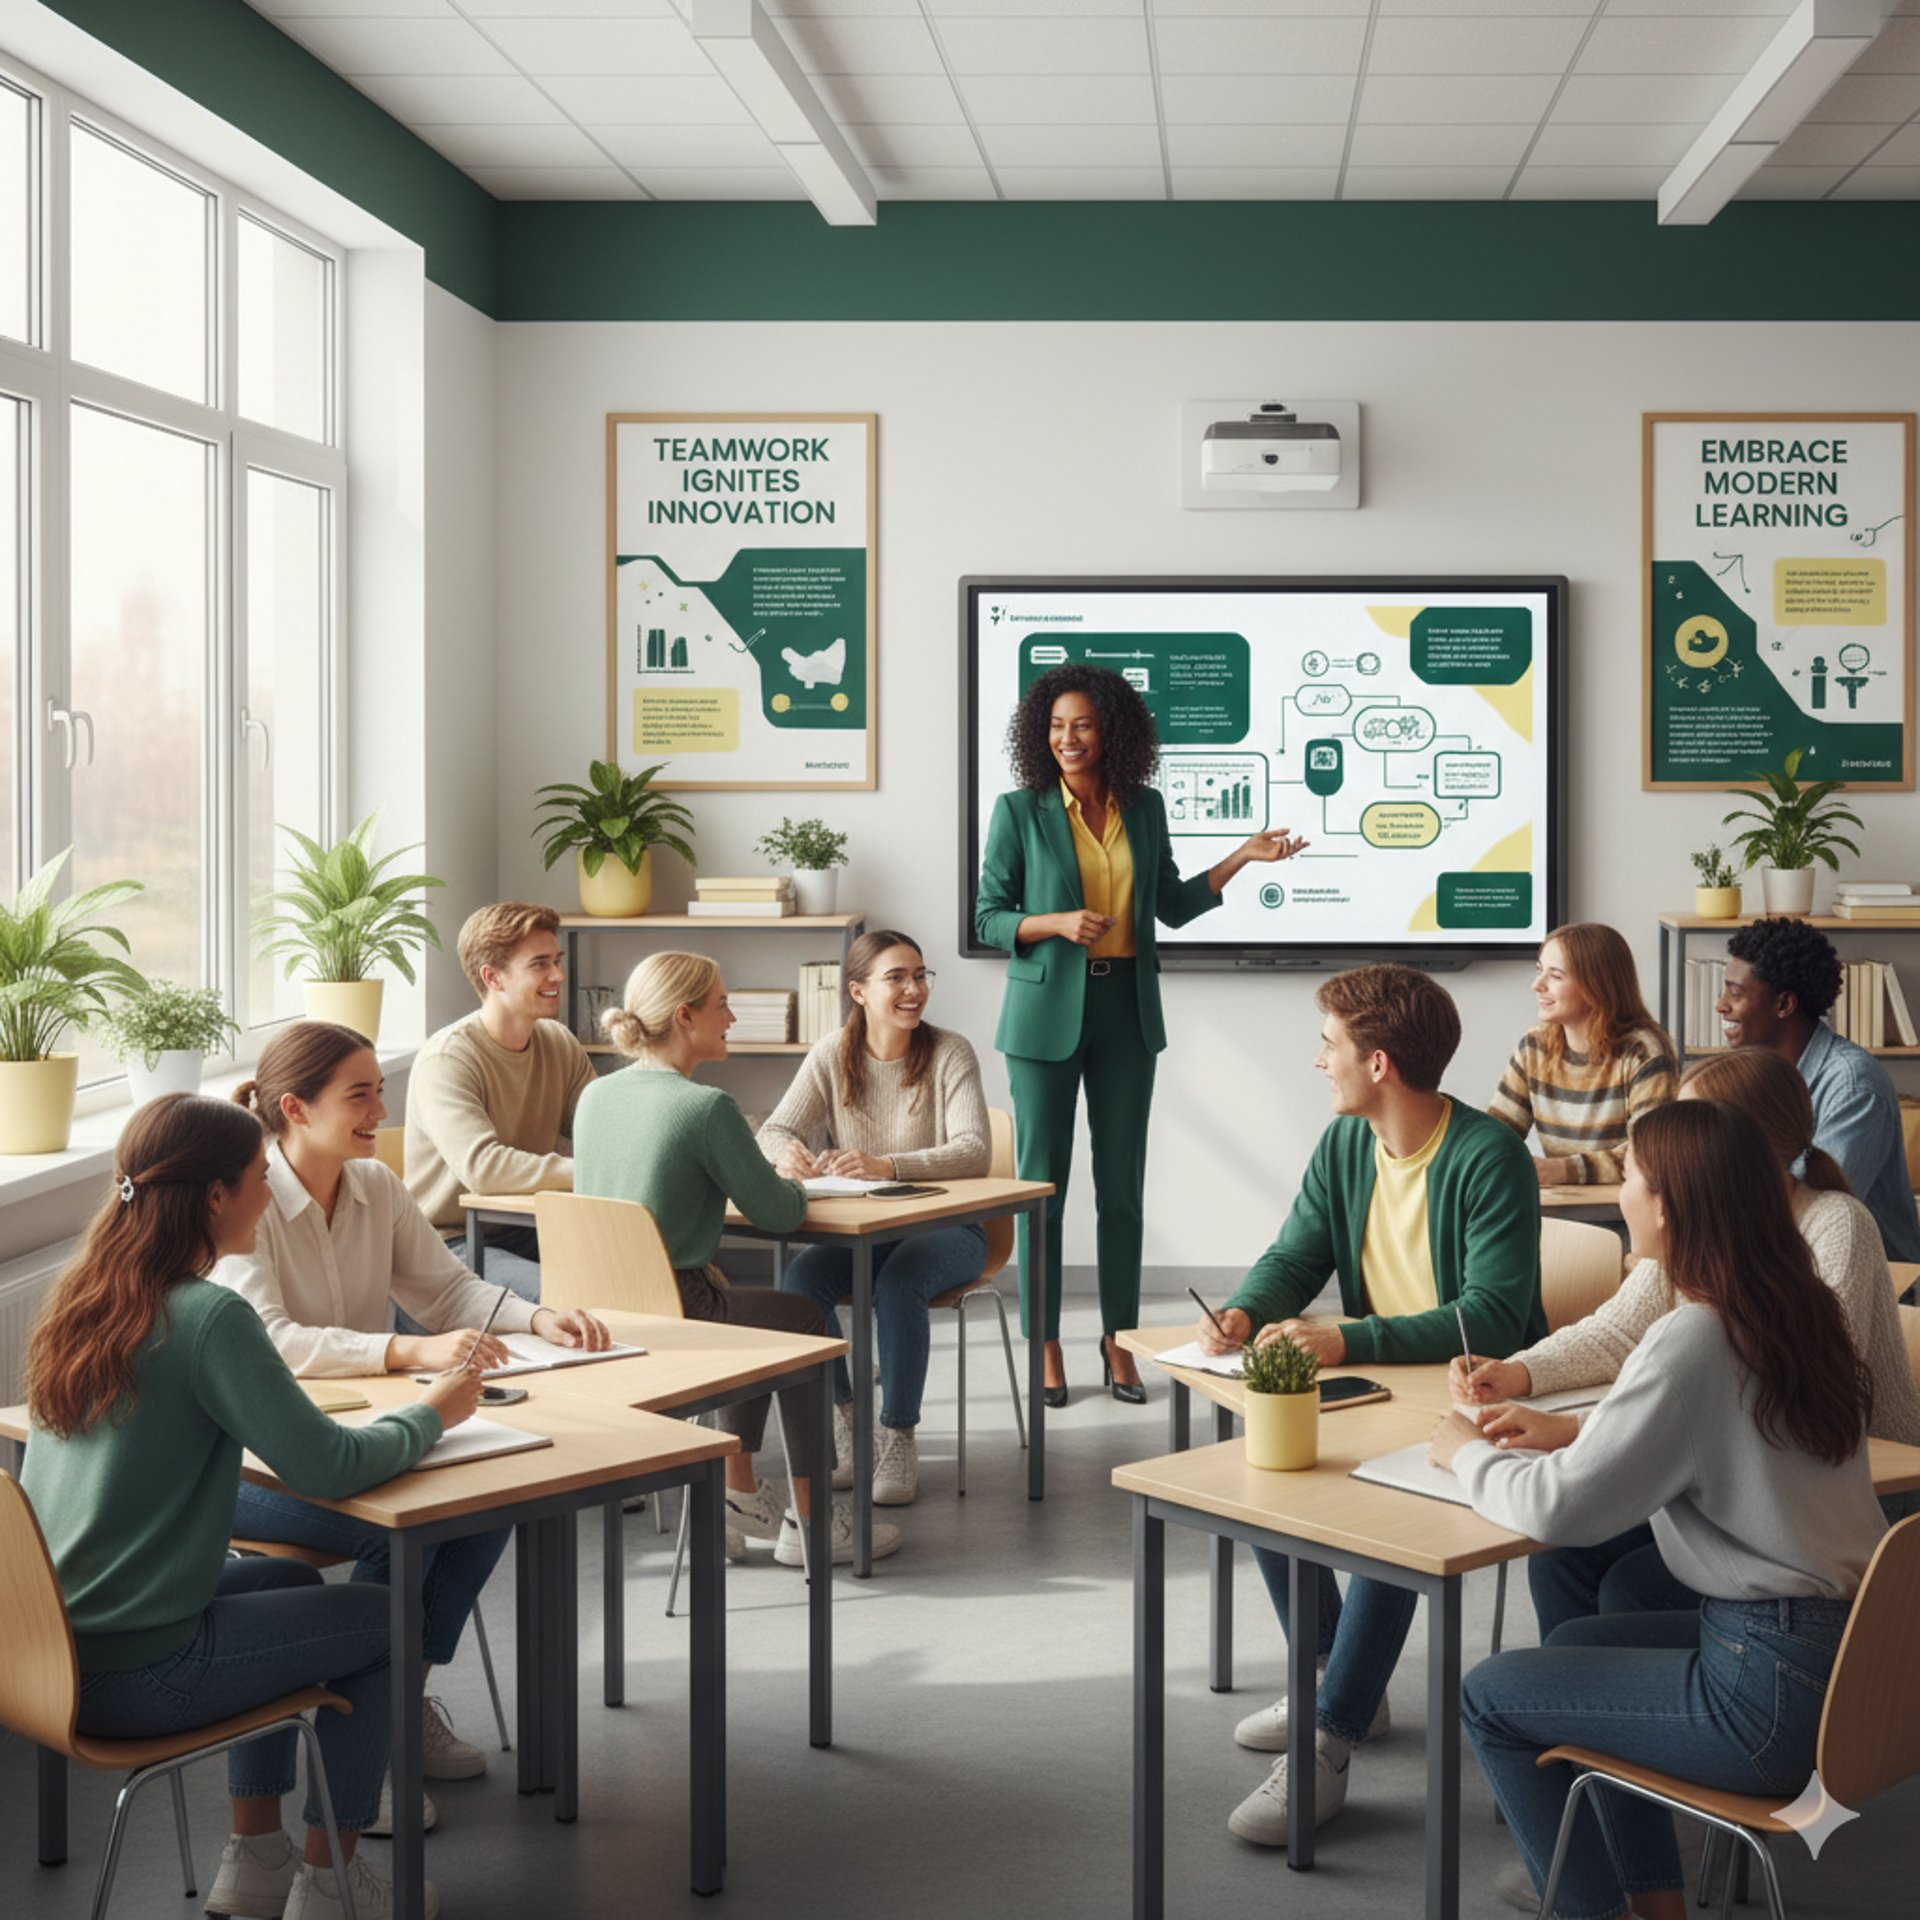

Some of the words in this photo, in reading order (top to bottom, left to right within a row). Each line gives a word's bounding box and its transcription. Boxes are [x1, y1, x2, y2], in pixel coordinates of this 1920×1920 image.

[653, 438, 829, 462] TEAMWORK
[1701, 440, 1848, 464] EMBRACE
[683, 469, 800, 493] IGNITES
[1705, 471, 1837, 495] MODERN
[648, 500, 835, 524] INNOVATION
[1696, 503, 1848, 528] LEARNING
